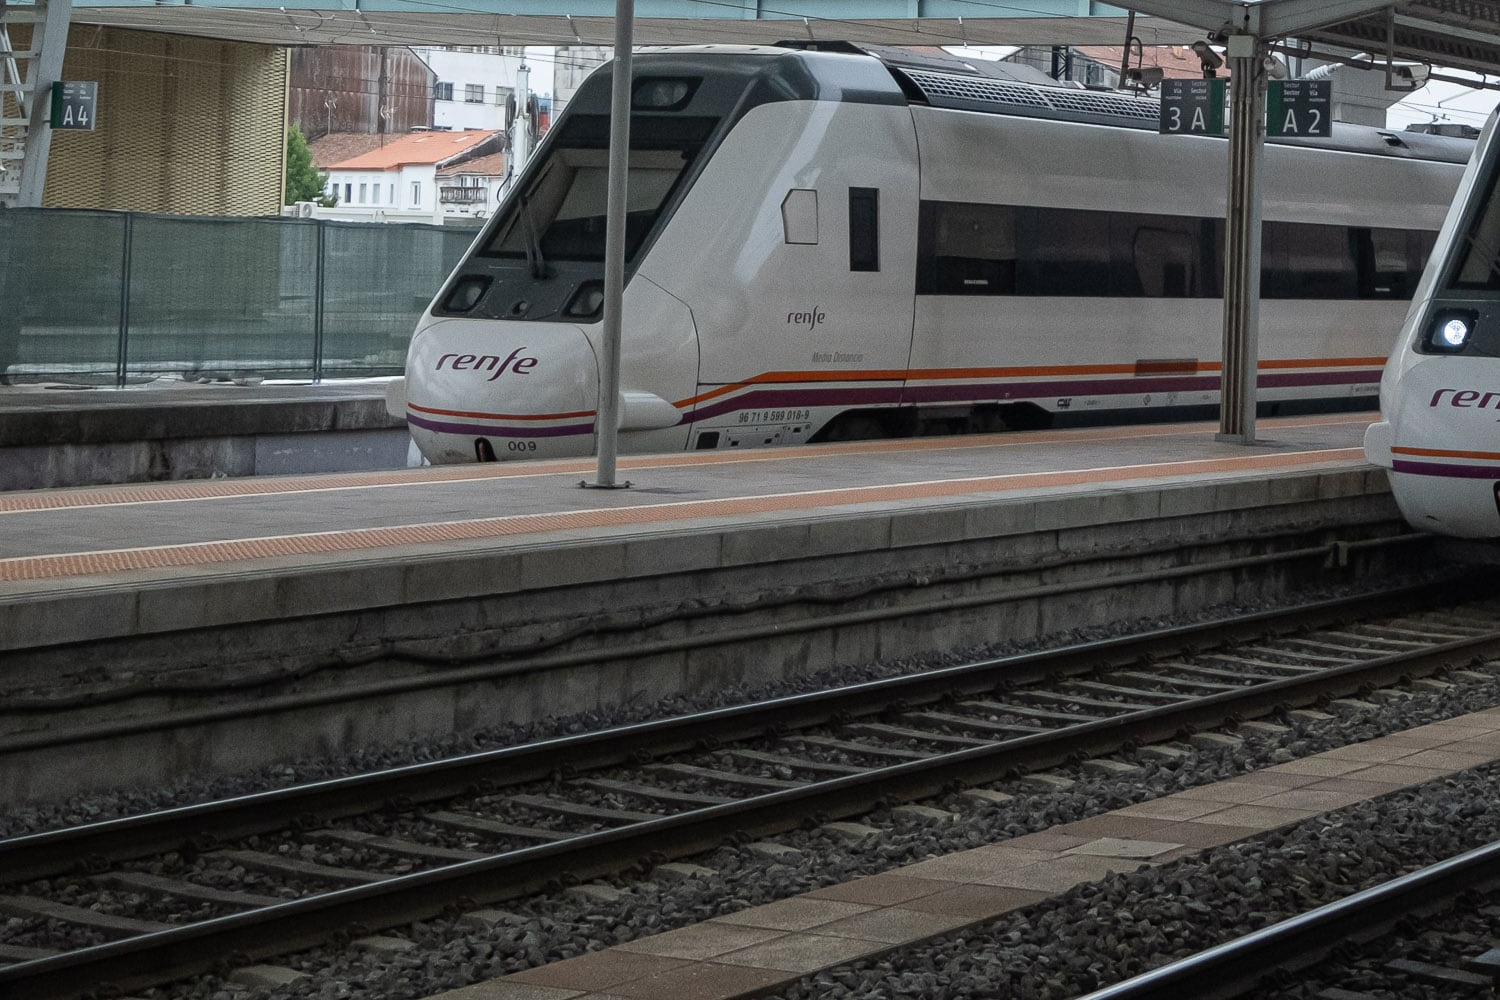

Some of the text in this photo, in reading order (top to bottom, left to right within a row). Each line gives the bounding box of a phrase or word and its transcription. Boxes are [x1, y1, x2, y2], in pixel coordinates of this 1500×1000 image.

[63, 105, 89, 126] A 4
[1168, 106, 1206, 131] 3 A
[1282, 108, 1321, 134] A 2
[787, 304, 826, 331] renfe
[435, 346, 539, 382] renfe
[738, 411, 749, 423] 96
[751, 411, 760, 422] 71
[763, 411, 769, 421] 9
[770, 410, 785, 421] 599
[507, 440, 537, 452] 009
